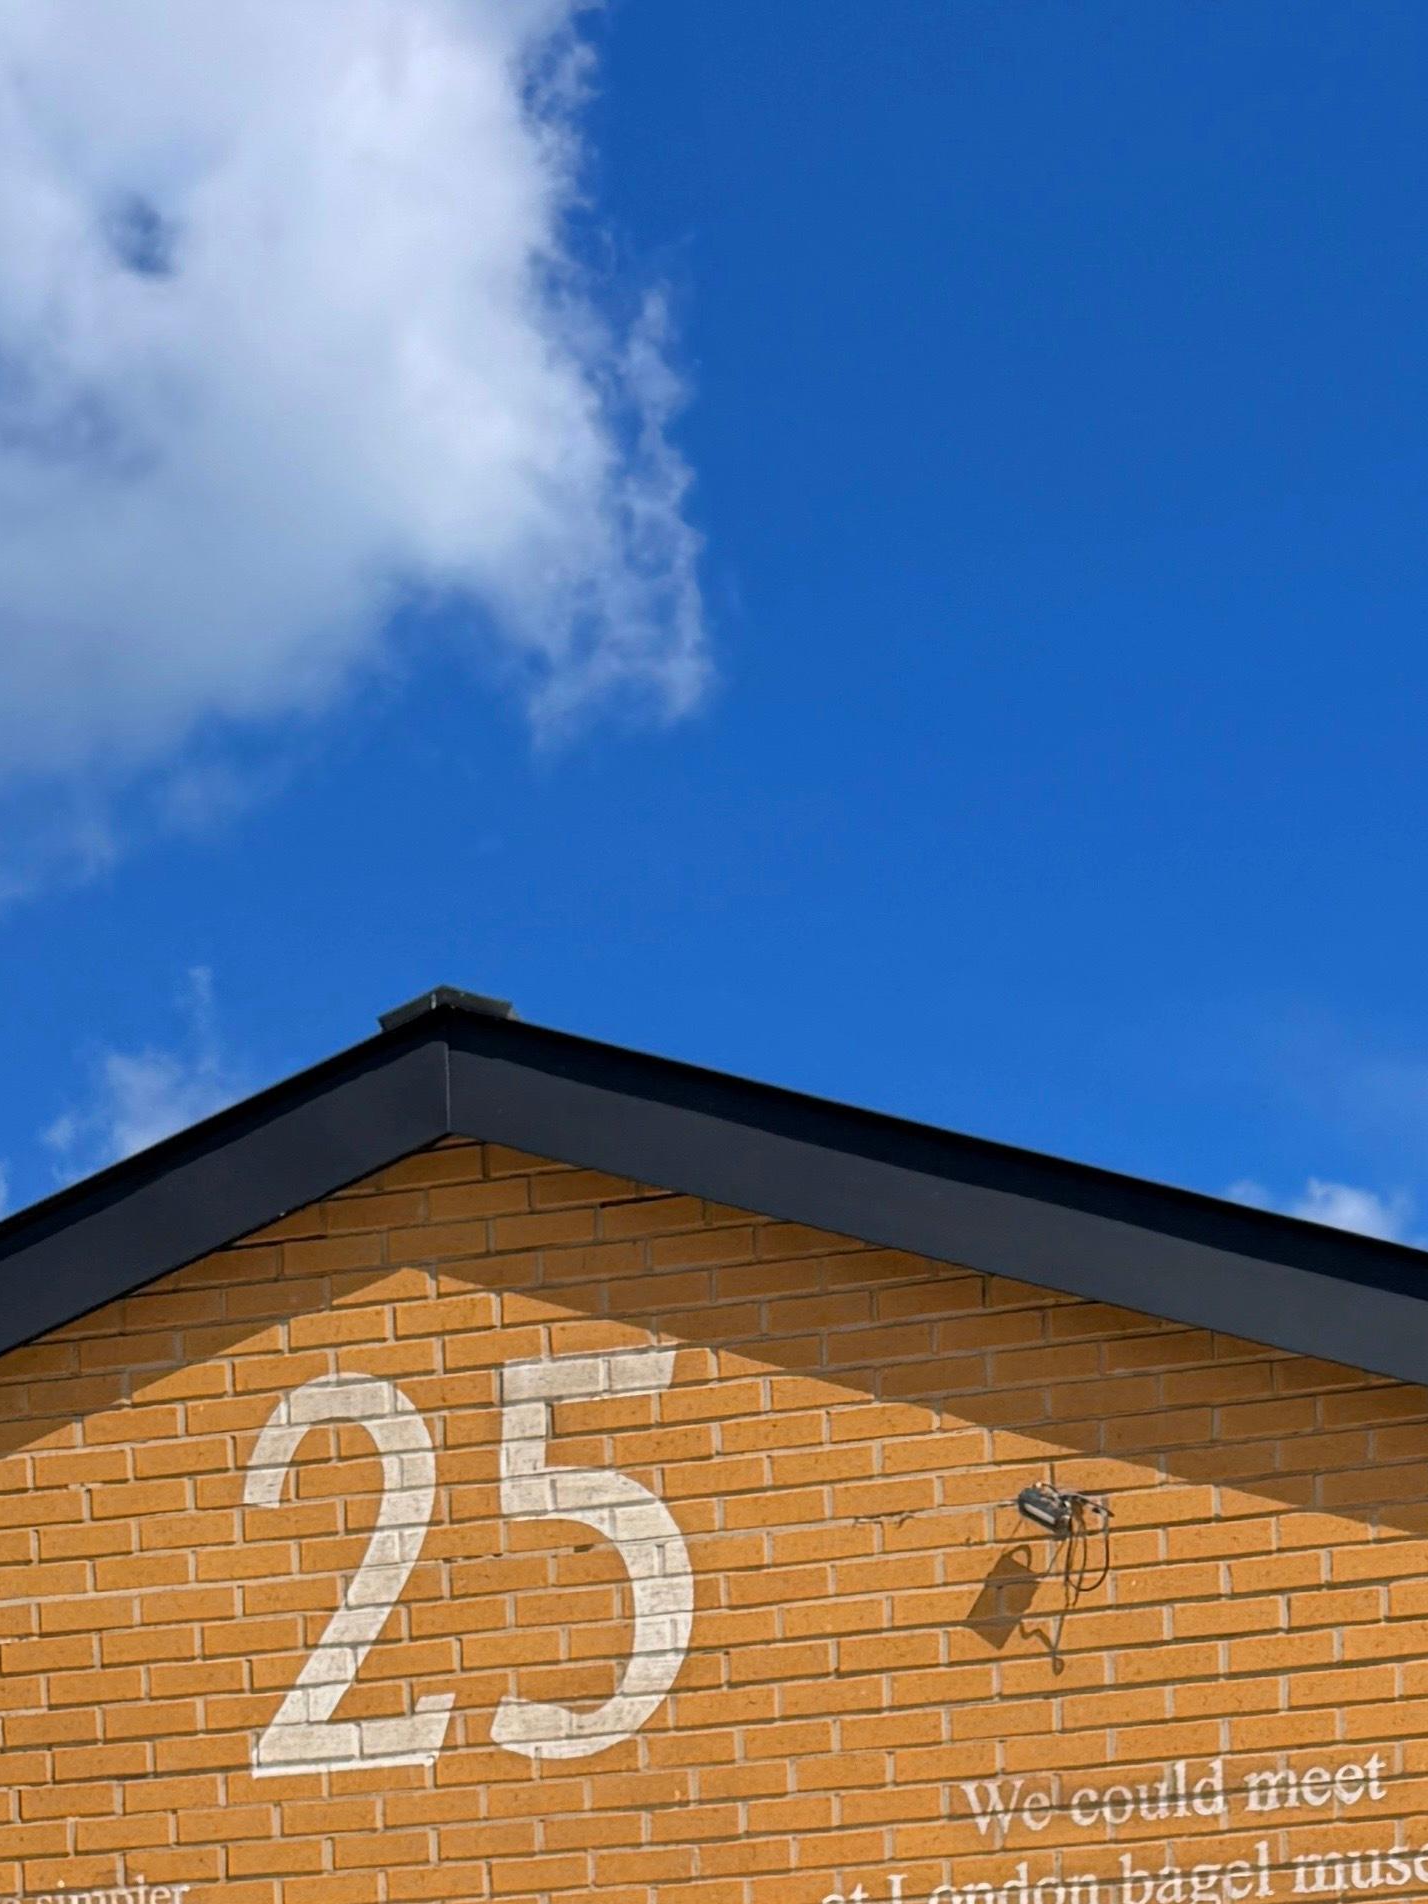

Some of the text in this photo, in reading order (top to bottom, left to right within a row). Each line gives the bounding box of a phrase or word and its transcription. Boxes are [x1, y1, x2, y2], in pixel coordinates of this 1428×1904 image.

[243, 1348, 694, 1778] 25
[960, 1752, 1387, 1836] We could meet
